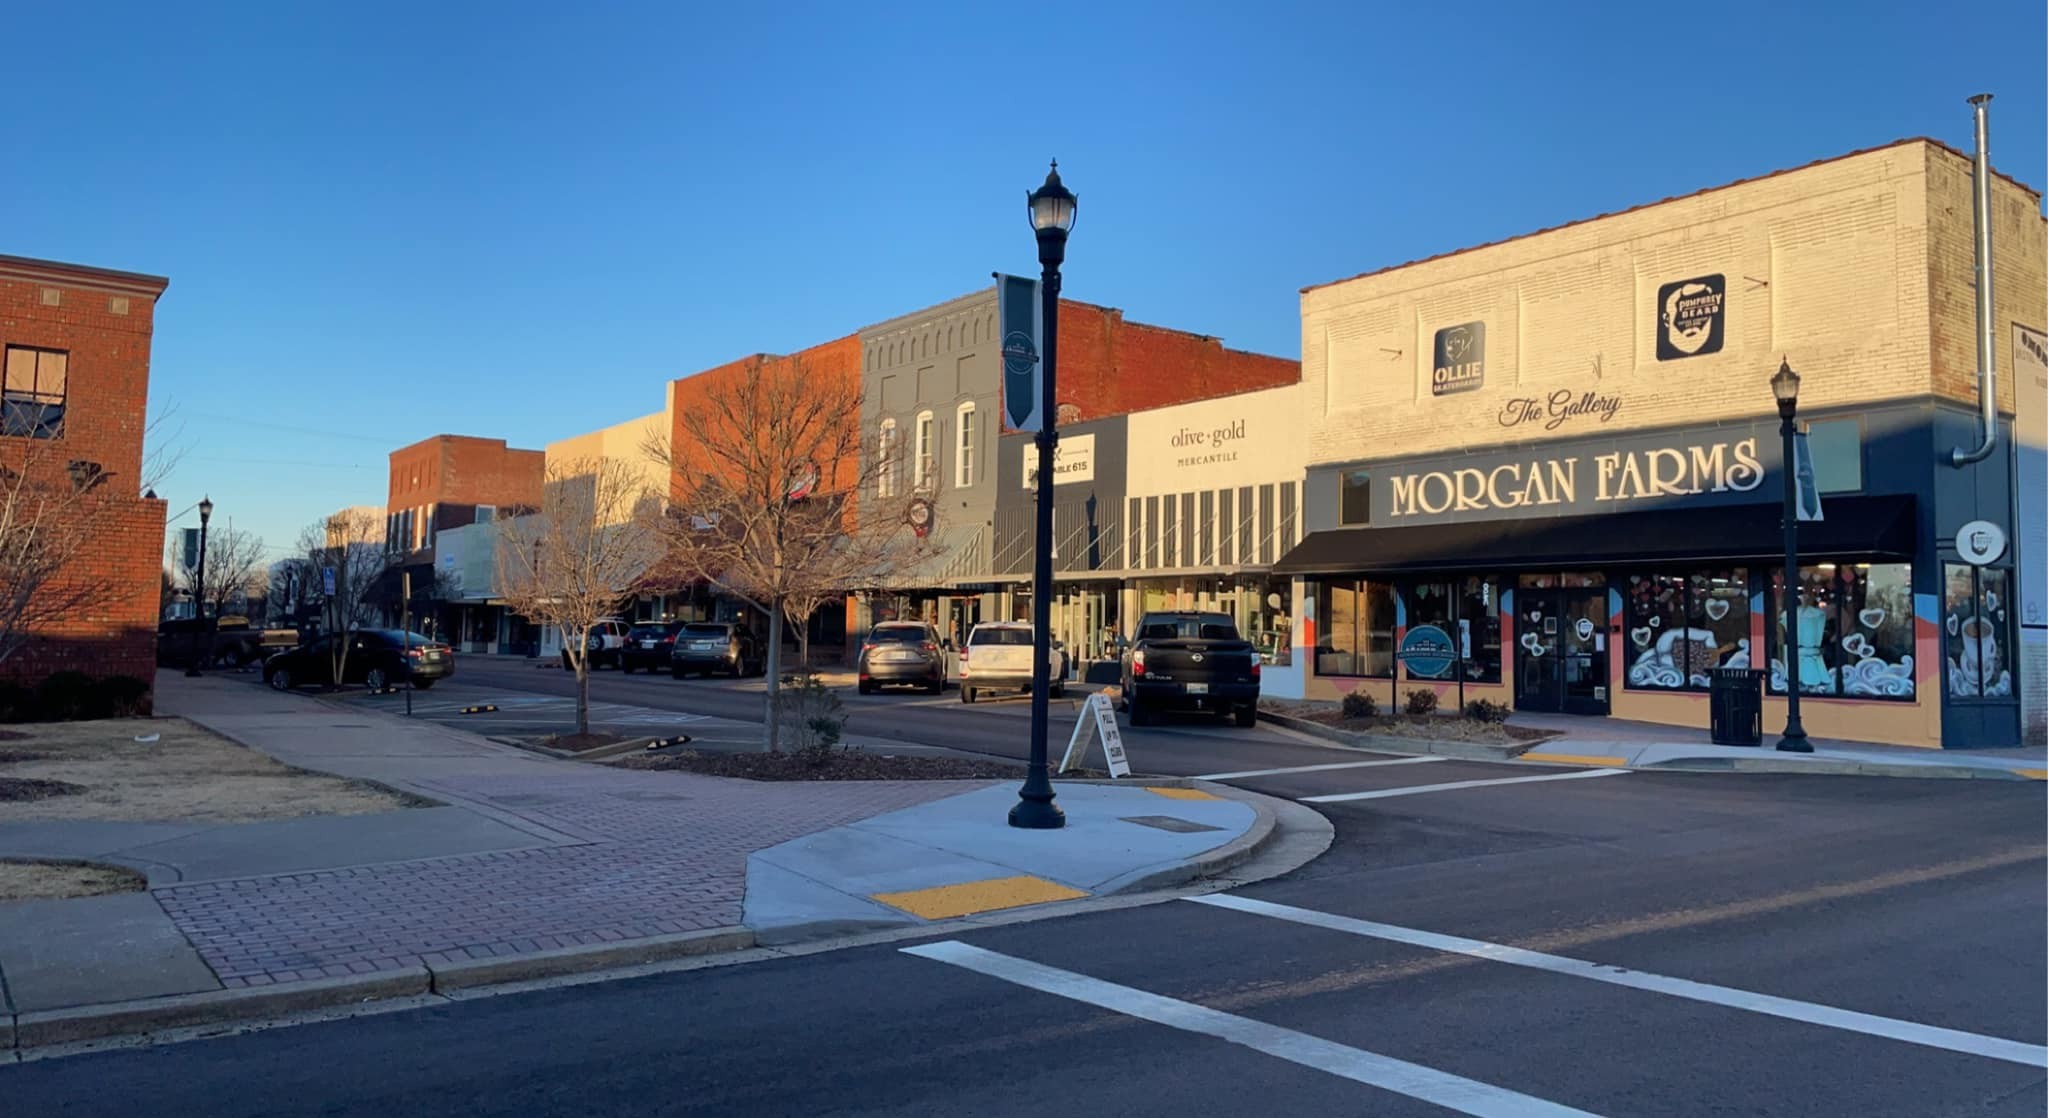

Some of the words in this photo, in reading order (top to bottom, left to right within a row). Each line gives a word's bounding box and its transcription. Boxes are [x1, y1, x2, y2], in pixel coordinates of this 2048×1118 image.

[1682, 305, 1719, 319] BEARD
[1434, 361, 1482, 384] OLLIE
[1498, 397, 1542, 427] The
[1545, 389, 1623, 430] Gallery
[1171, 427, 1205, 448] olive
[1212, 418, 1245, 448] gold
[1072, 460, 1088, 473] 615
[1177, 451, 1238, 467] MERCANTILE
[1389, 457, 1579, 517] MORGAN
[1594, 438, 1766, 501] FARMS
